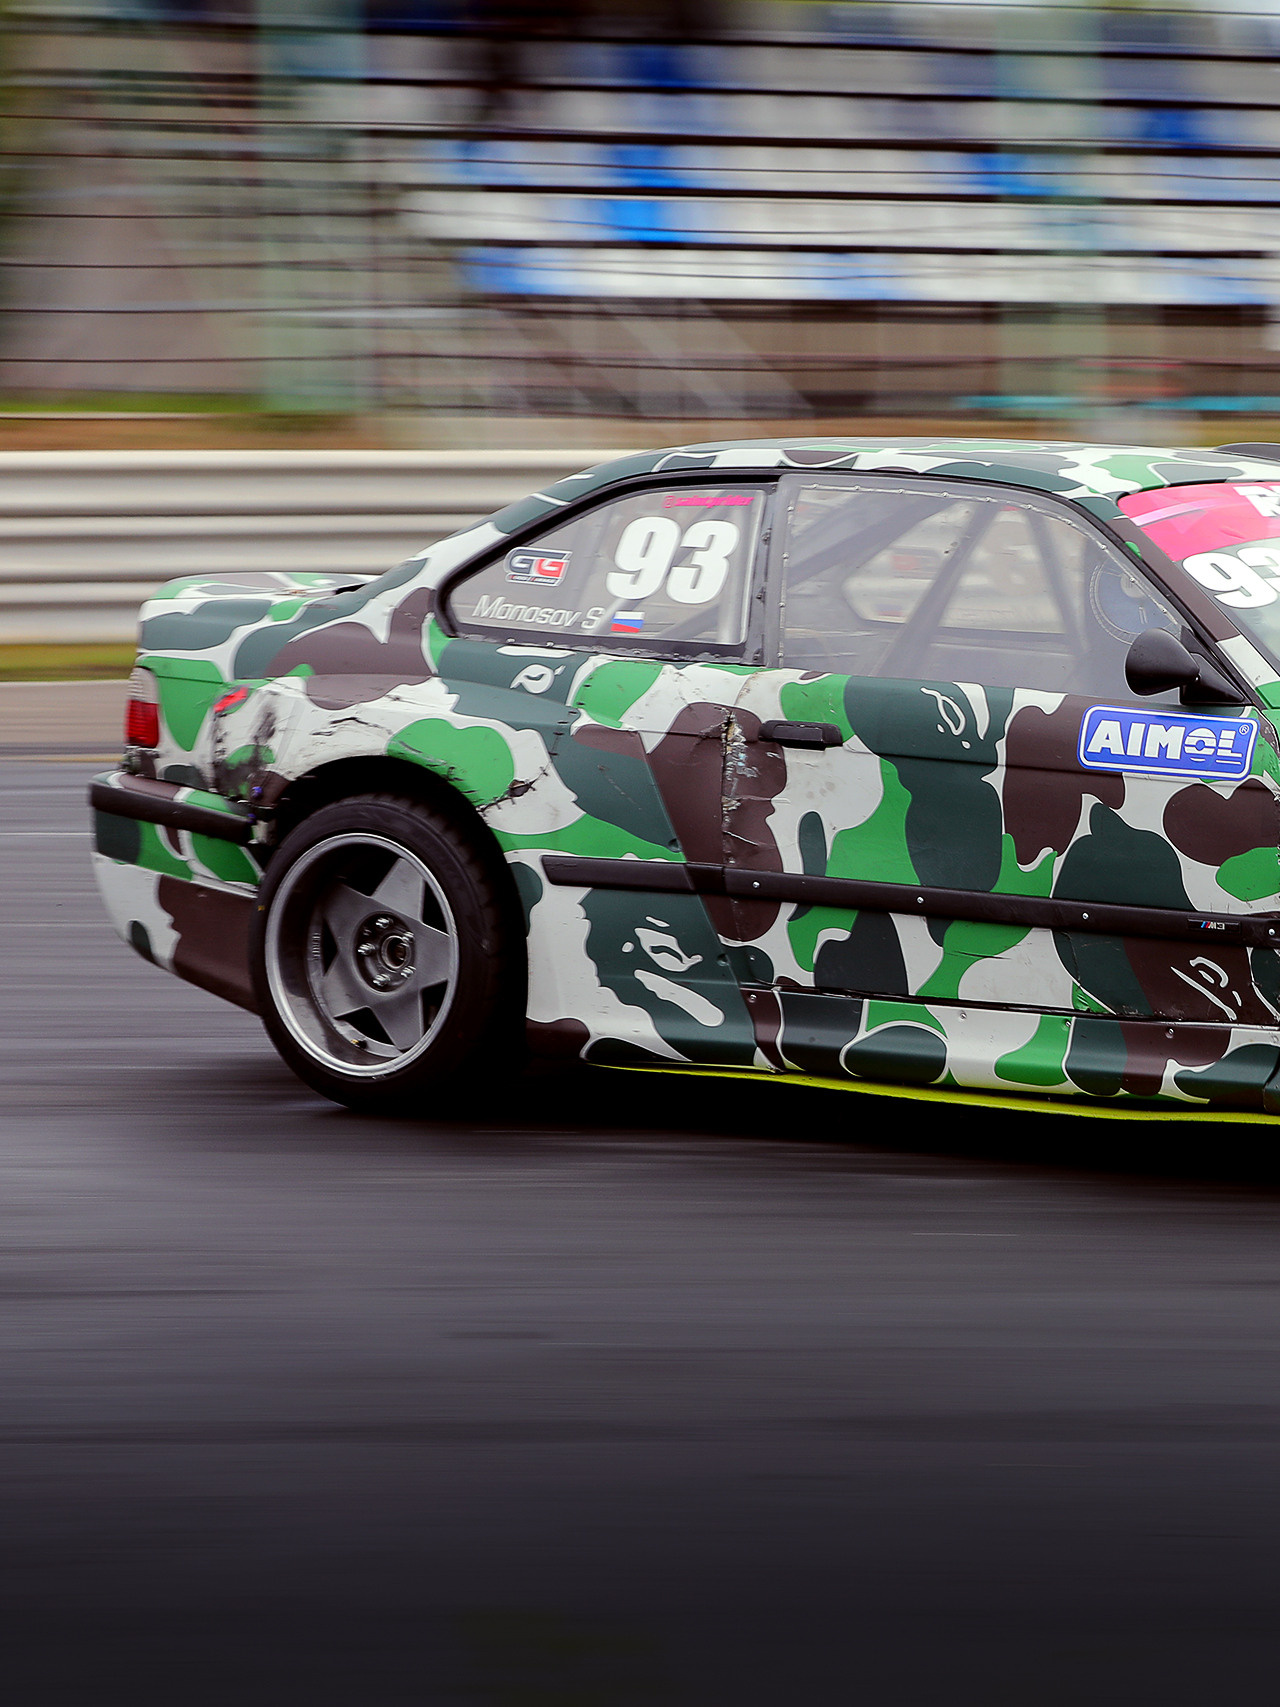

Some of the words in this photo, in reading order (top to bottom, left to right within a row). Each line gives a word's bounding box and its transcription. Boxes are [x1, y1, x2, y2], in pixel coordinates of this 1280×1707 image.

[606, 516, 740, 605] 93
[582, 607, 606, 630] S
[1086, 719, 1243, 765] AIMOL
